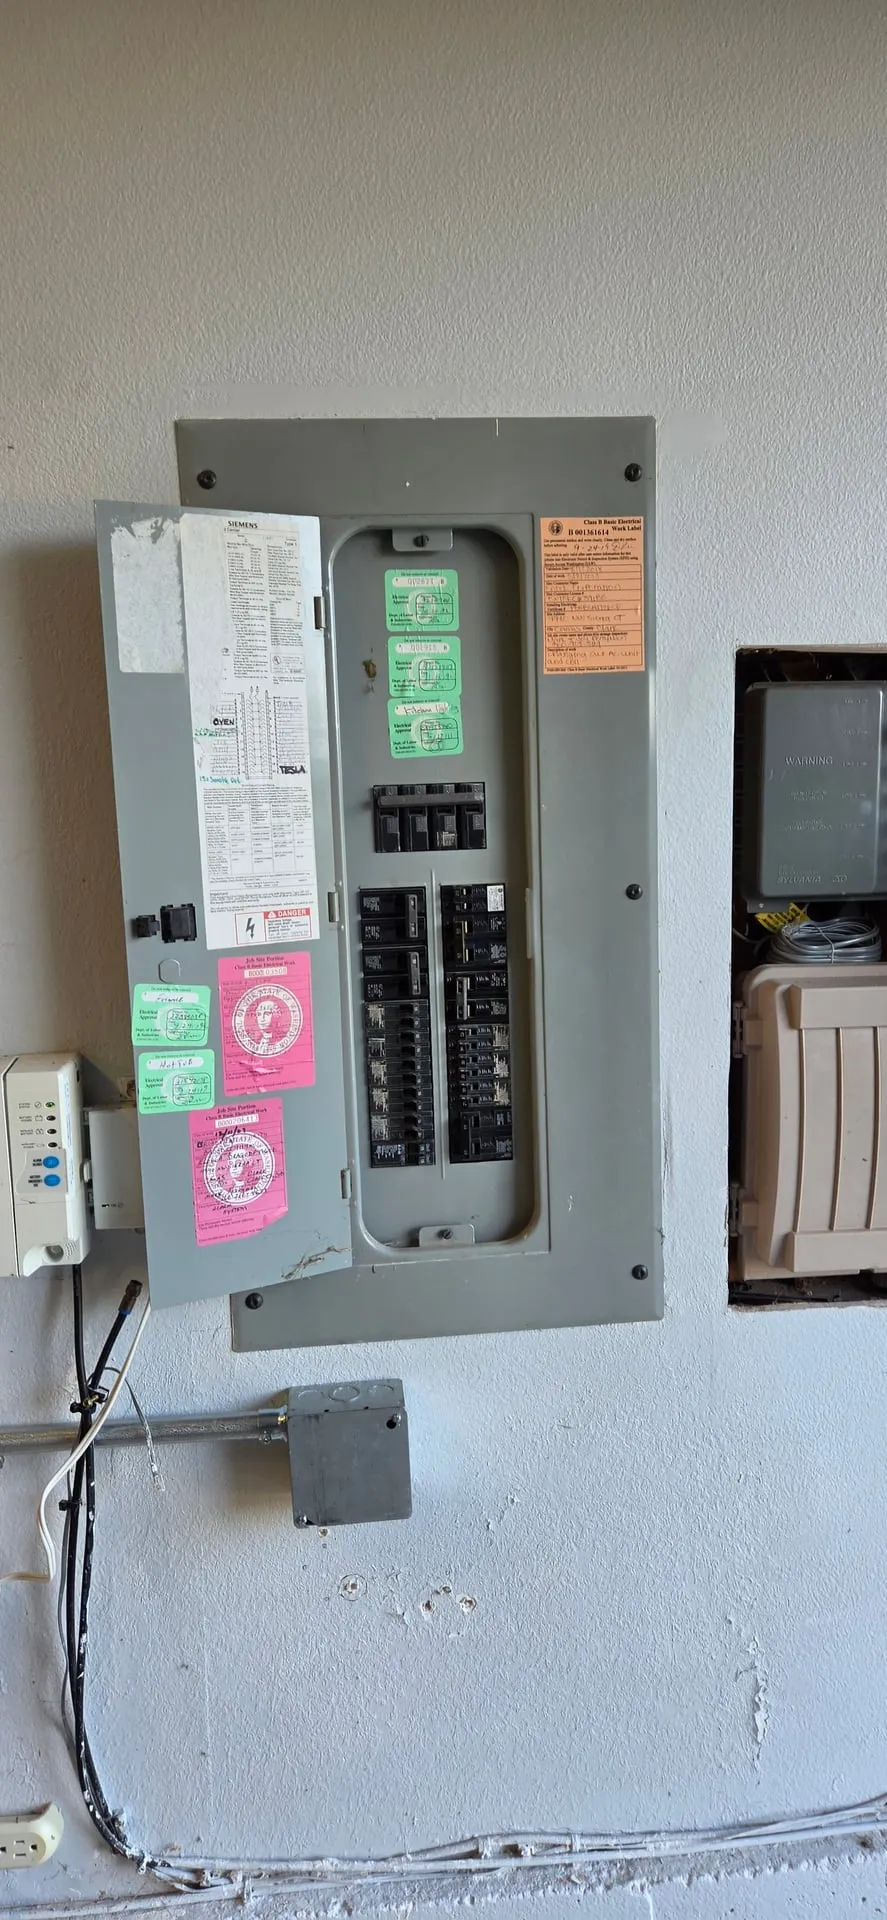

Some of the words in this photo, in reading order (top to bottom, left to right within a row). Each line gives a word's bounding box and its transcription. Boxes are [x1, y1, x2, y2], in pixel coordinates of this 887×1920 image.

[228, 521, 258, 529] SIEMENS
[785, 756, 833, 765] WARNING
[279, 765, 306, 774] TESLA
[278, 909, 306, 917] DANGER
